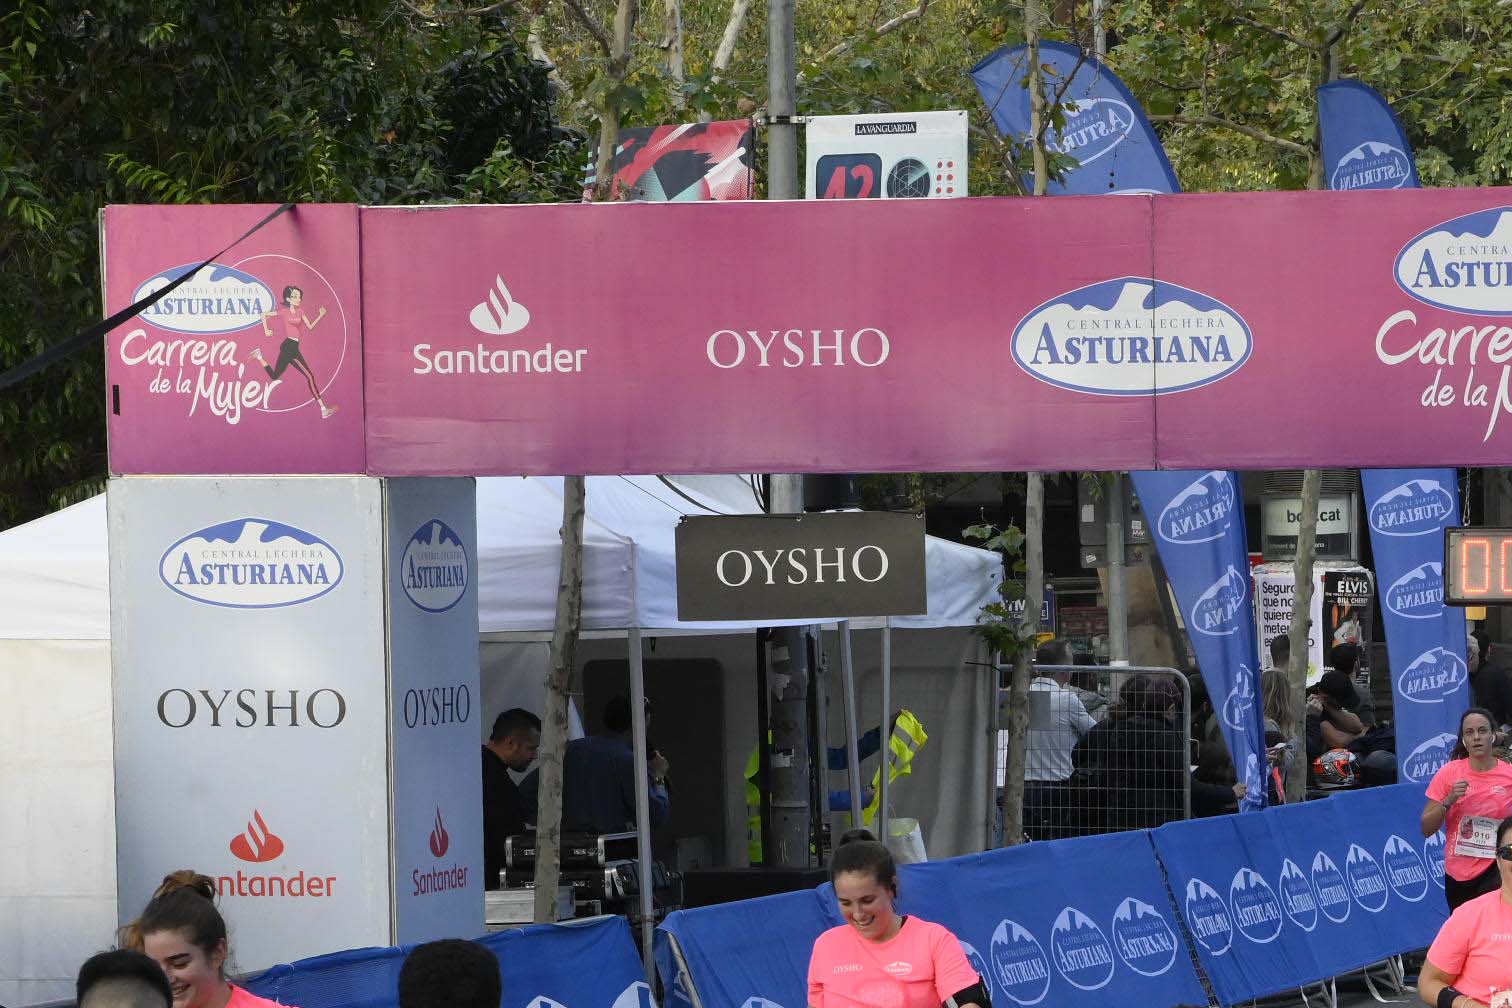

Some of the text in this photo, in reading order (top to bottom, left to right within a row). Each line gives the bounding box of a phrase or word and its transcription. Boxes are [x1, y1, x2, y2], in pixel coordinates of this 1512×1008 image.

[857, 124, 915, 134] LA VANGUARDIA
[1066, 317, 1226, 330] CENTRAL LECHERA
[120, 329, 238, 366] Carrera
[413, 341, 588, 375] Santander
[705, 327, 891, 369] OYSHO
[1029, 322, 1235, 366] ASTURIANA
[150, 363, 282, 424] de la Mujer
[1421, 368, 1455, 407] de
[1463, 368, 1488, 407] la
[173, 551, 331, 586] ASTURIANA
[201, 549, 324, 559] CENTRAL LECHERA
[716, 545, 889, 587] OYSHO
[406, 555, 465, 590] ASTURIANA
[1337, 581, 1368, 593] ELVIS
[1263, 597, 1278, 610] que
[156, 688, 347, 728] OYSHO
[403, 684, 470, 729] OYSHO
[216, 870, 337, 897] ntander
[412, 863, 468, 896] Santander
[1000, 956, 1048, 987] ASTURIANA
[1058, 942, 1112, 973] ASTURIANA
